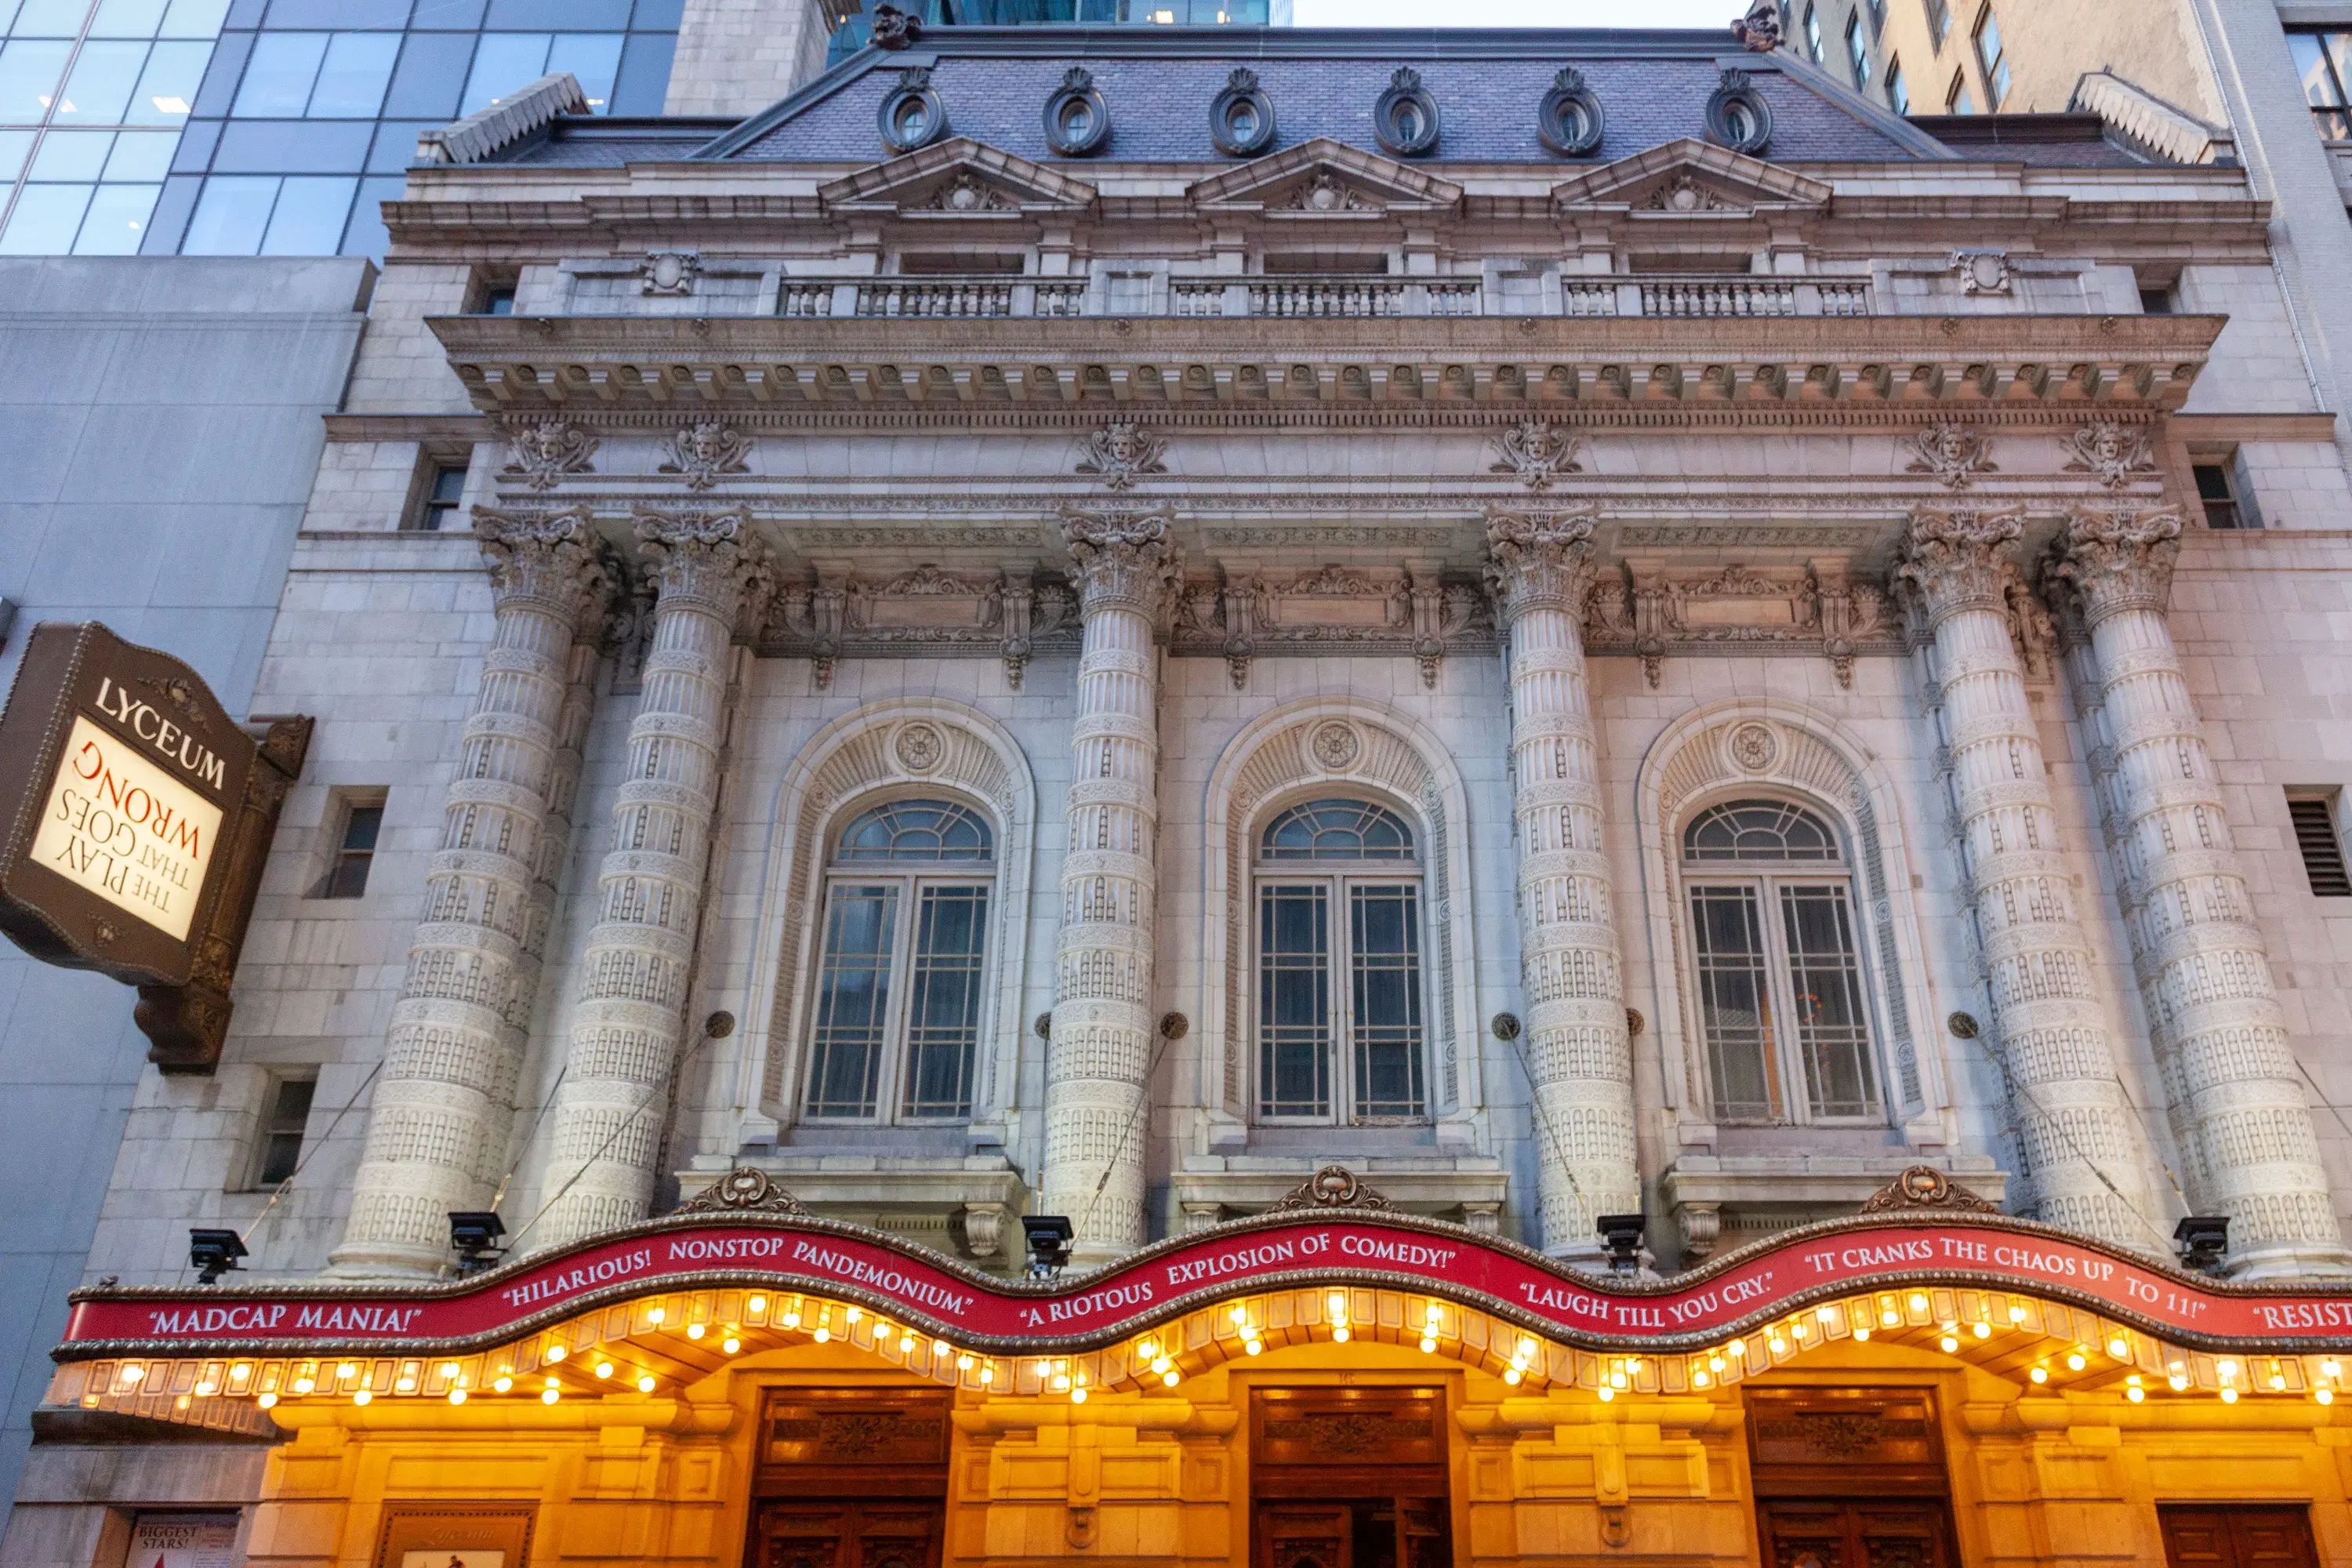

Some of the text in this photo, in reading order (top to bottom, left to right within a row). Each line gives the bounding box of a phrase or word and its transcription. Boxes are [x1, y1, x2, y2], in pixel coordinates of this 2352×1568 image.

[96, 677, 225, 790] LYCEUM
[73, 741, 200, 860] WRONG
[56, 789, 189, 891] THAT GOES
[56, 835, 170, 913] THE PLAY
[503, 1238, 974, 1316] “HILARIOUS! NONSTOP PANDEMONIUM.”
[1020, 1233, 1456, 1327] “A RIOTOUS EXPLOSION OF COMEDY!”
[1520, 1272, 1773, 1327] “LAUGH TILL YOU CRY.”
[1805, 1237, 2206, 1319] “IT CRANKS THE CHAOS UP TO 11!”
[2252, 1302, 2352, 1330] “RESIST
[149, 1305, 423, 1334] “MADCAP MANIA!”
[140, 1527, 197, 1537] BIGGEST
[141, 1538, 189, 1549] STARS!
